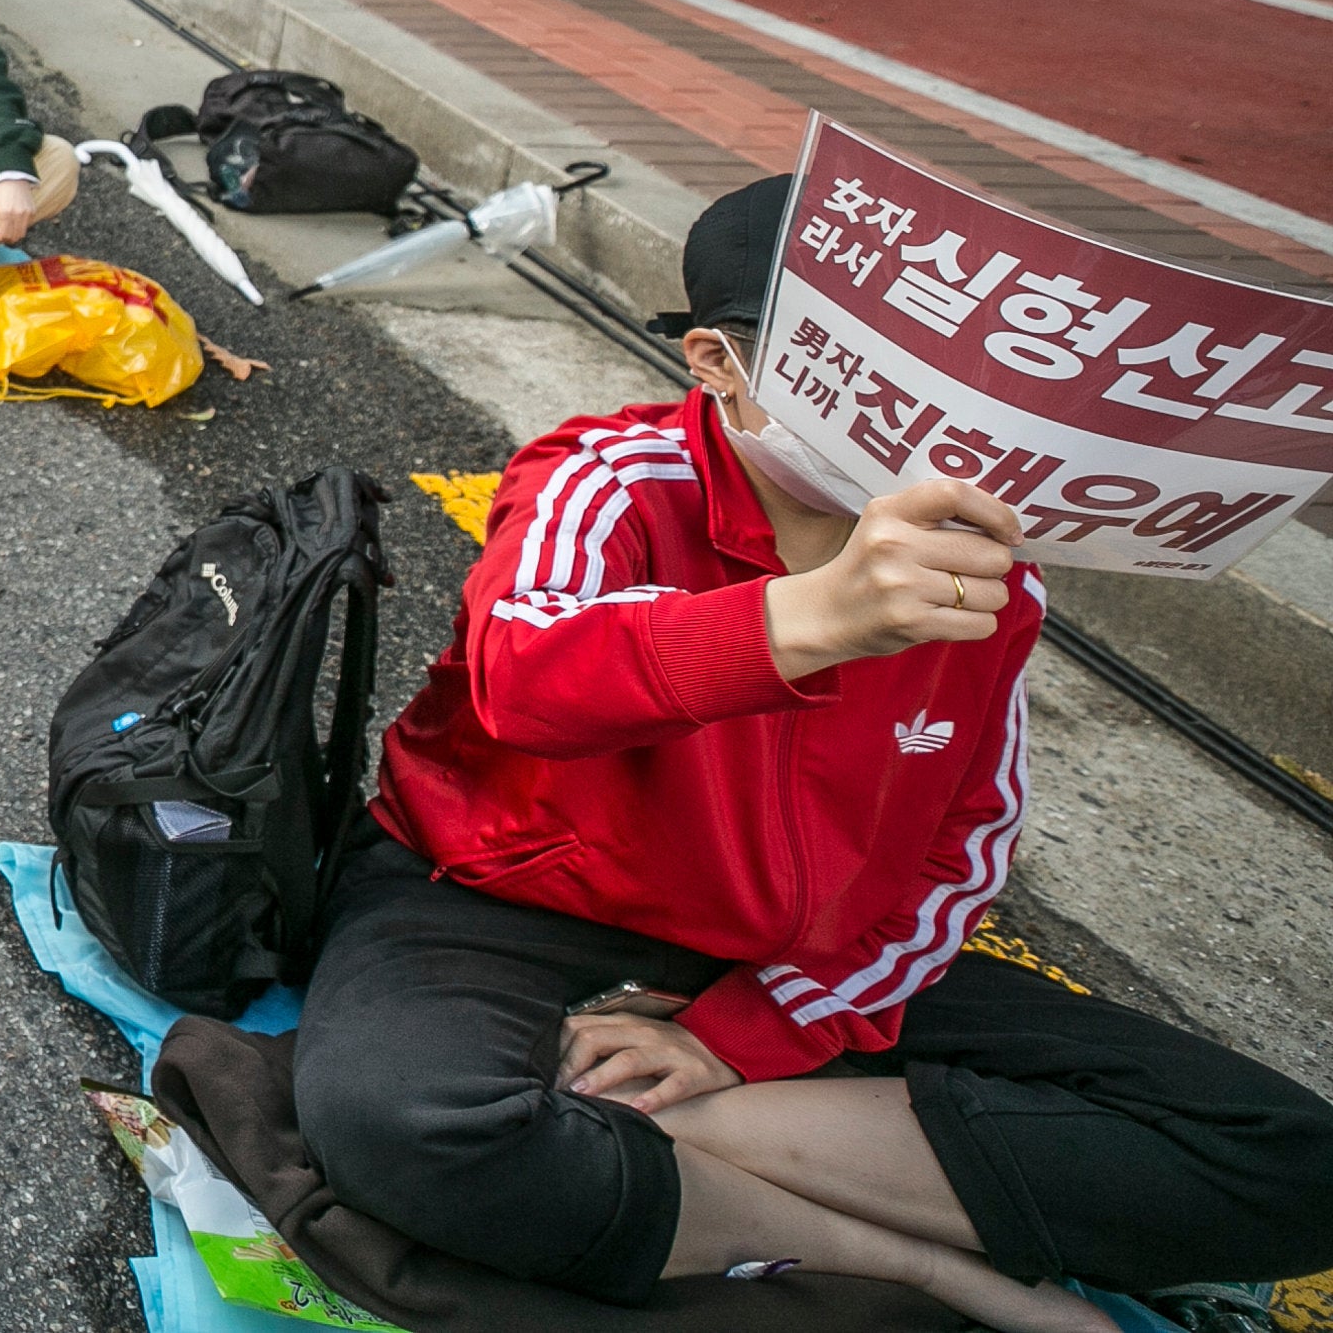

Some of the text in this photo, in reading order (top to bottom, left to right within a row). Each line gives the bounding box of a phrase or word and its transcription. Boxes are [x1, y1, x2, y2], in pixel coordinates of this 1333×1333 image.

[824, 177, 917, 248] 女자
[799, 215, 885, 289] 라서
[790, 316, 865, 383] 男자
[883, 230, 1333, 434] 실형선고
[774, 351, 840, 421] 니까
